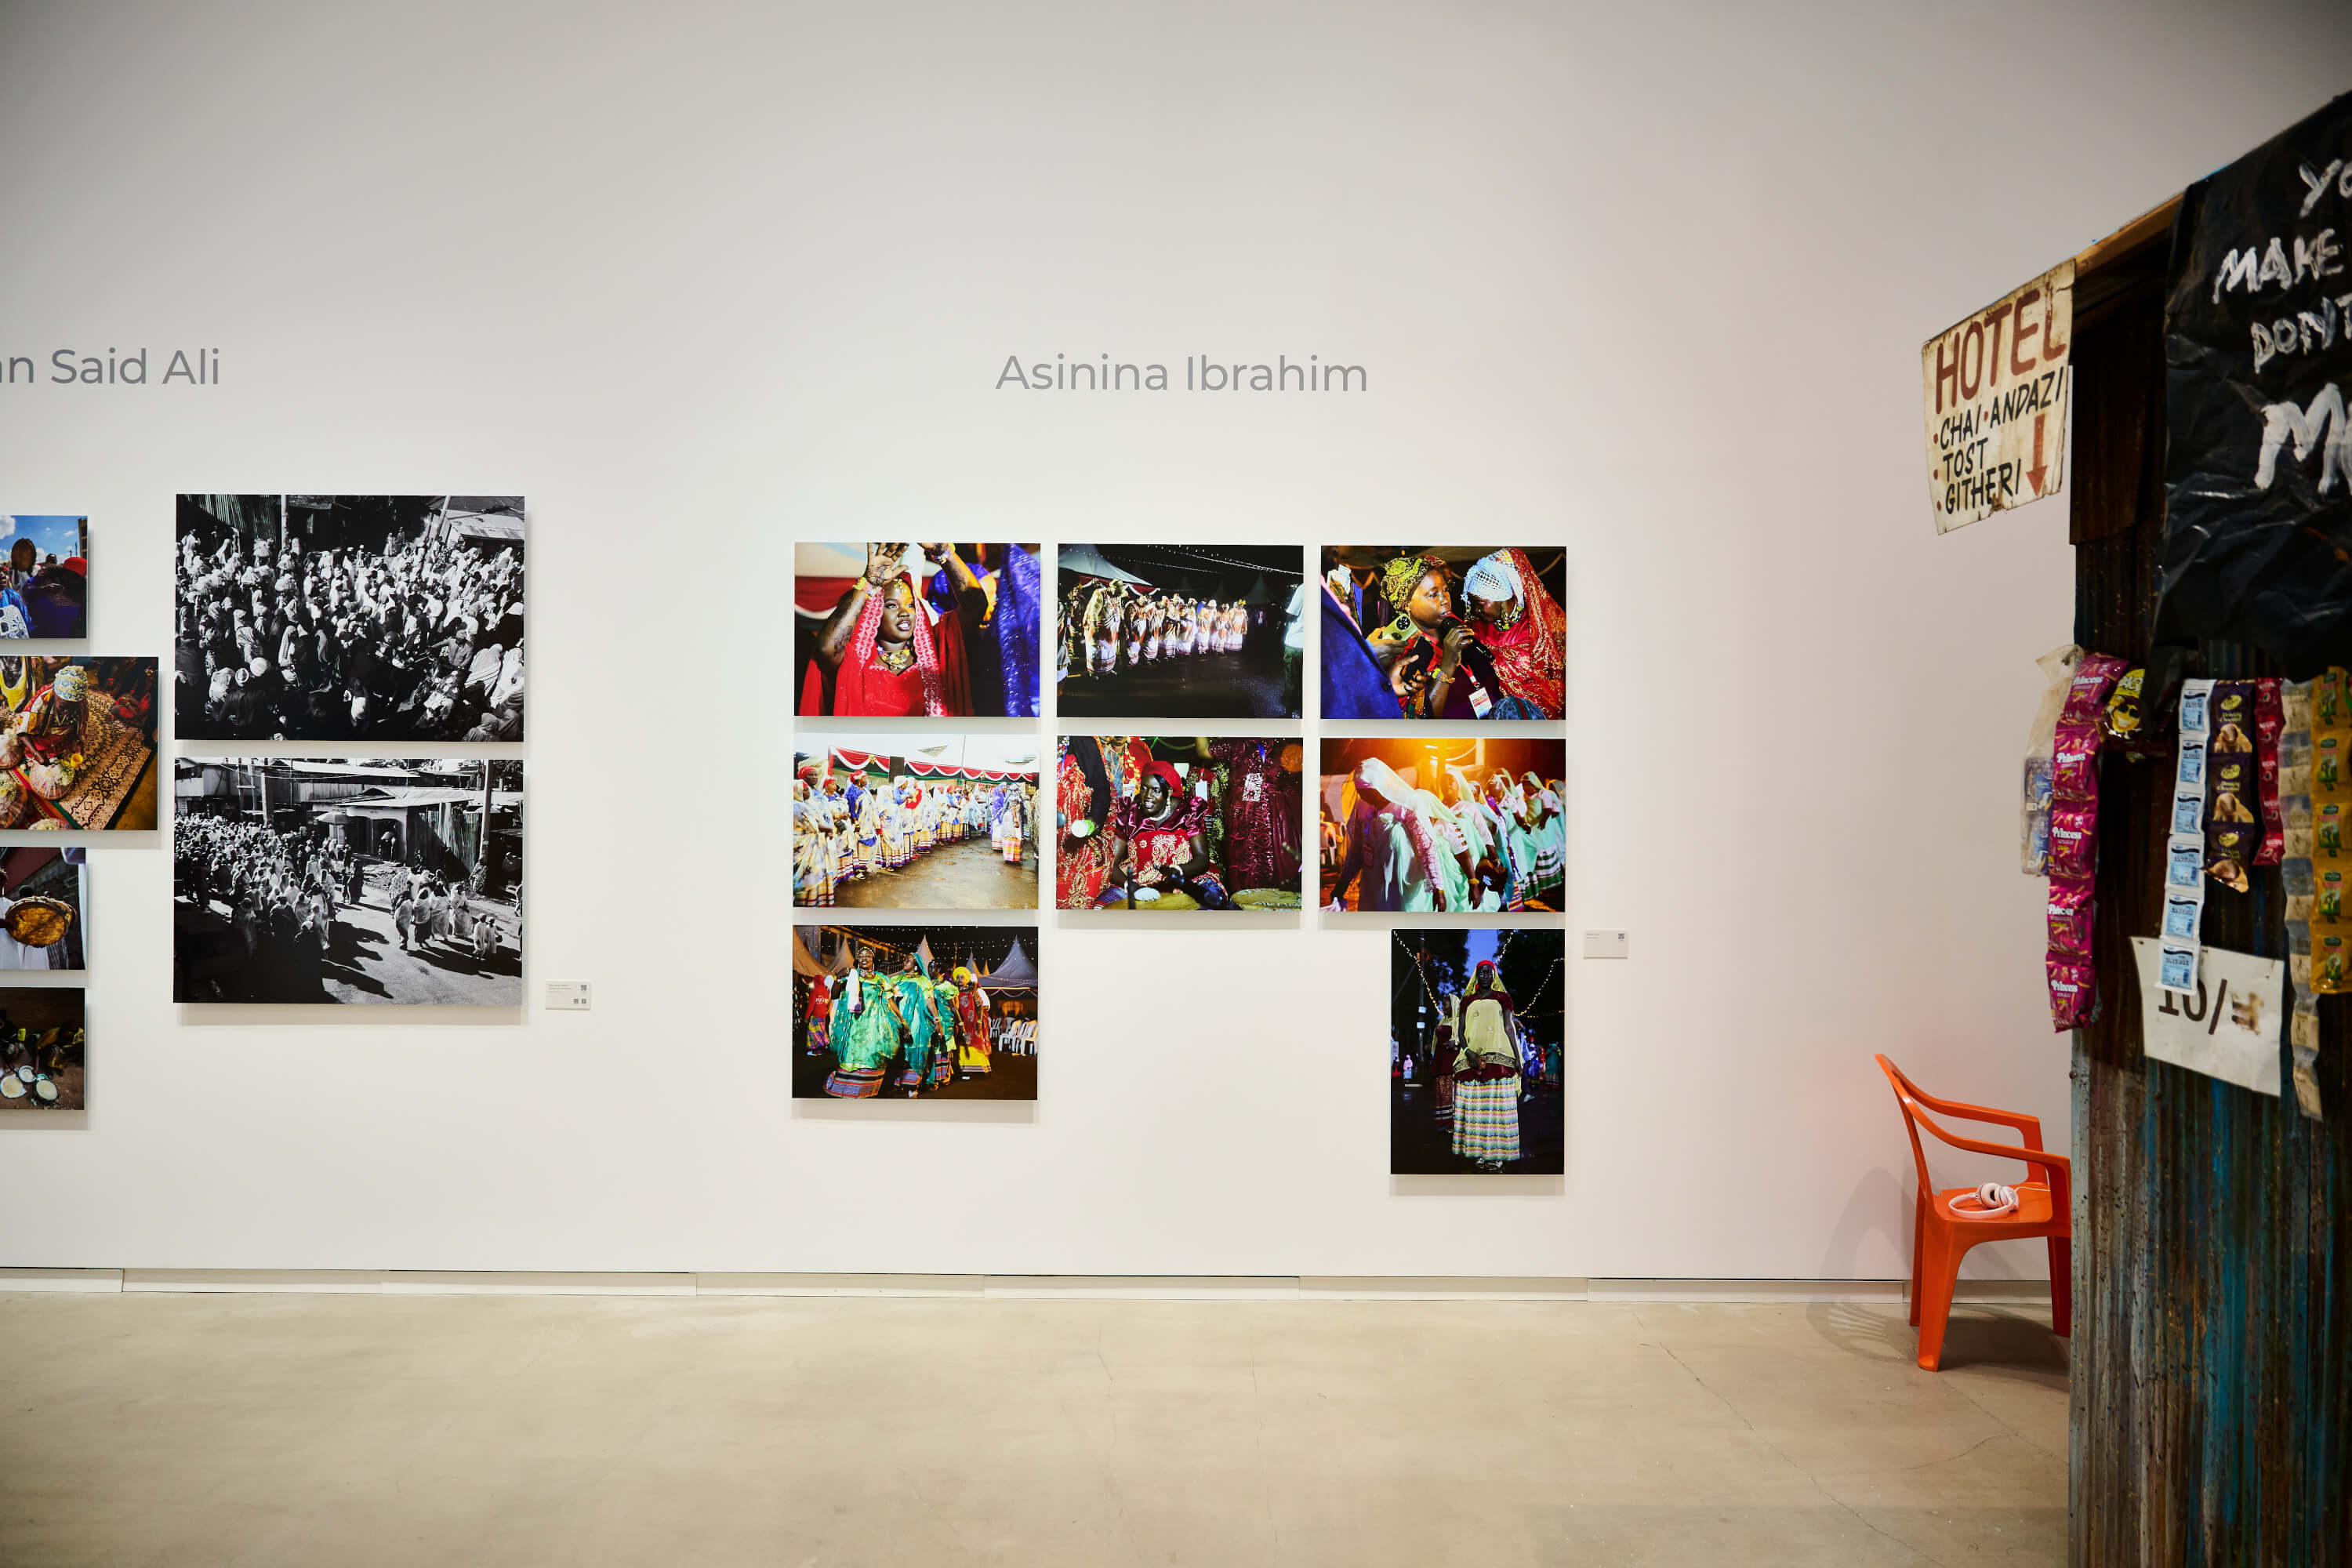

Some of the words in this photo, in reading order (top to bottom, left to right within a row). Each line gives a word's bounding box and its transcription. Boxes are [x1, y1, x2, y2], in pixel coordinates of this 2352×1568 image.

[2212, 228, 2344, 304] MAKE
[0, 357, 34, 383] n
[51, 347, 147, 384] Said
[162, 347, 220, 385] Ali
[995, 352, 1168, 390] Asinina
[1187, 354, 1367, 392] Ibrahim
[1935, 288, 2067, 415] HOTEL
[1940, 404, 1982, 450] CHAI
[1989, 366, 2064, 429] ANDAZI
[1943, 437, 1989, 482] TOST
[1945, 459, 2022, 514] GITHERI
[2052, 826, 2082, 840] Princess
[2051, 978, 2078, 993] Princess
